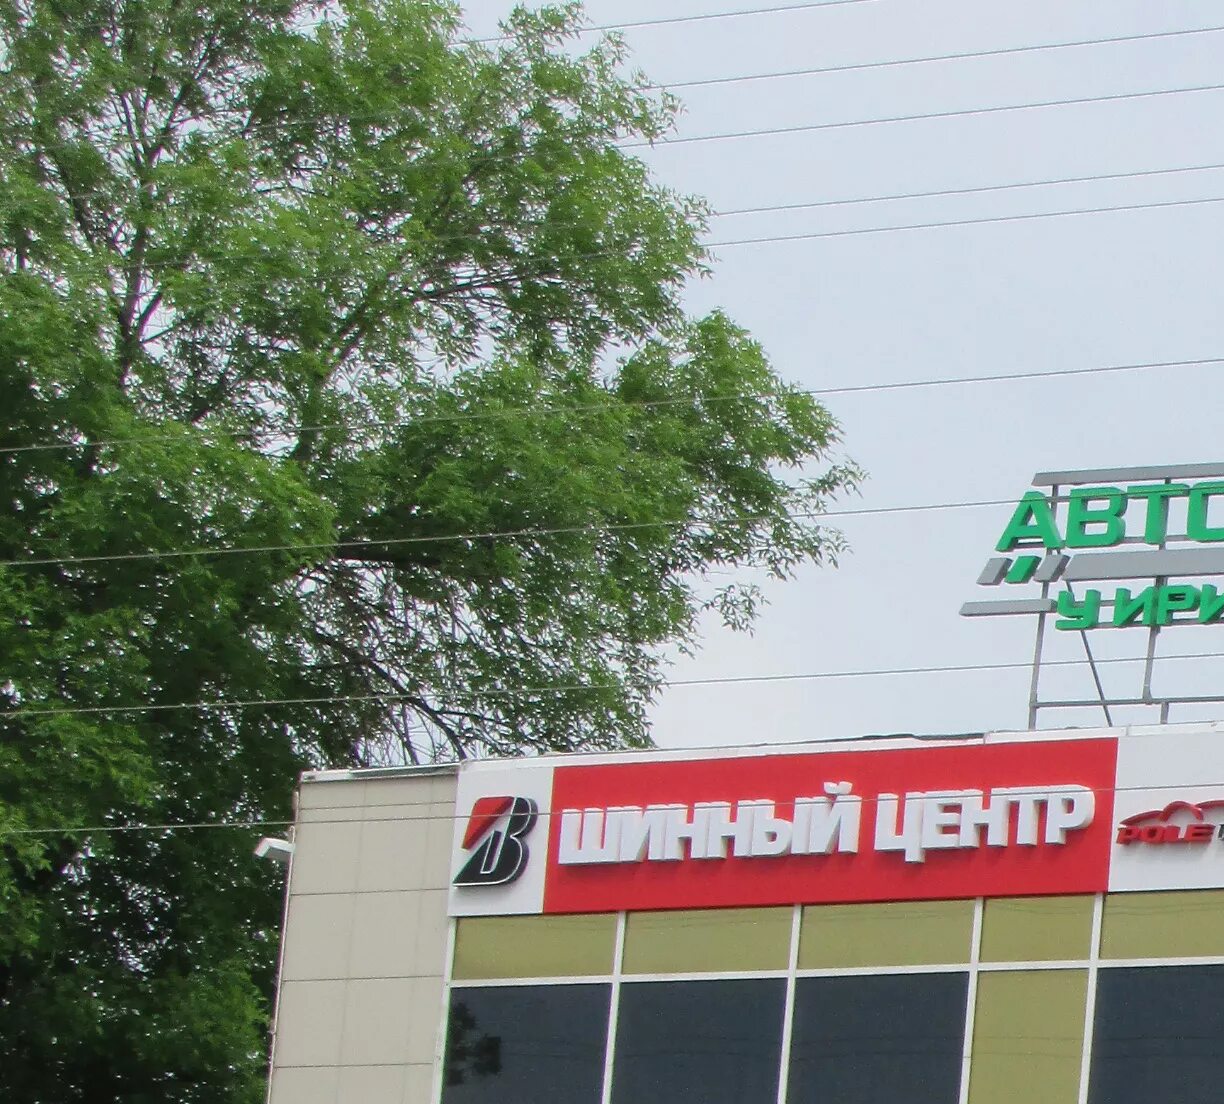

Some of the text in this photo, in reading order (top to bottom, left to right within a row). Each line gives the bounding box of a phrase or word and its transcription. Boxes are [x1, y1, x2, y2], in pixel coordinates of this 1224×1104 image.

[558, 781, 1096, 865] ШИННЫЙ ЦЕНТР
[1116, 823, 1216, 845] POLE
